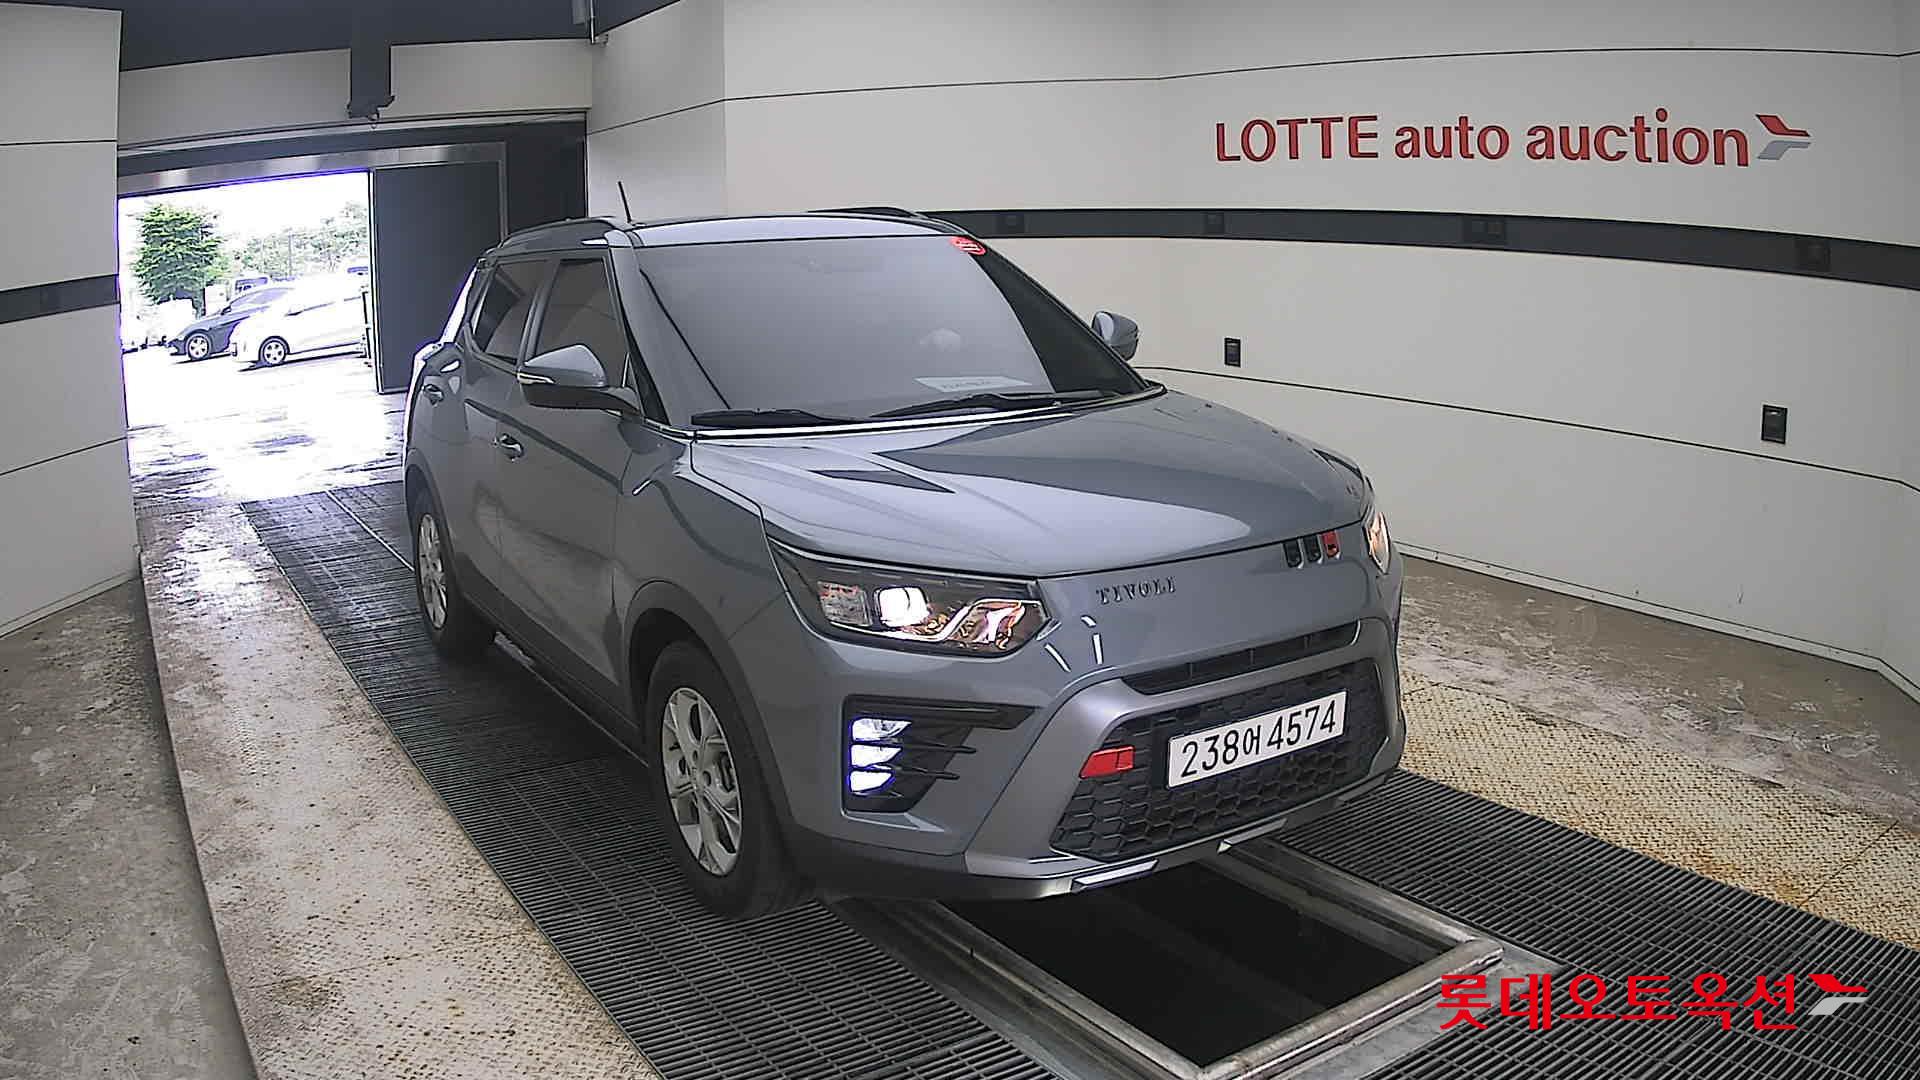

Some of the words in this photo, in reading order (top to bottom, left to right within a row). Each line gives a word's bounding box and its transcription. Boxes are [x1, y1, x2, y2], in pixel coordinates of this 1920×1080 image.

[1215, 115, 1378, 162] LOTTE
[1394, 115, 1511, 161] auto
[1526, 107, 1750, 167] auction
[1096, 576, 1176, 605] TIVOLI
